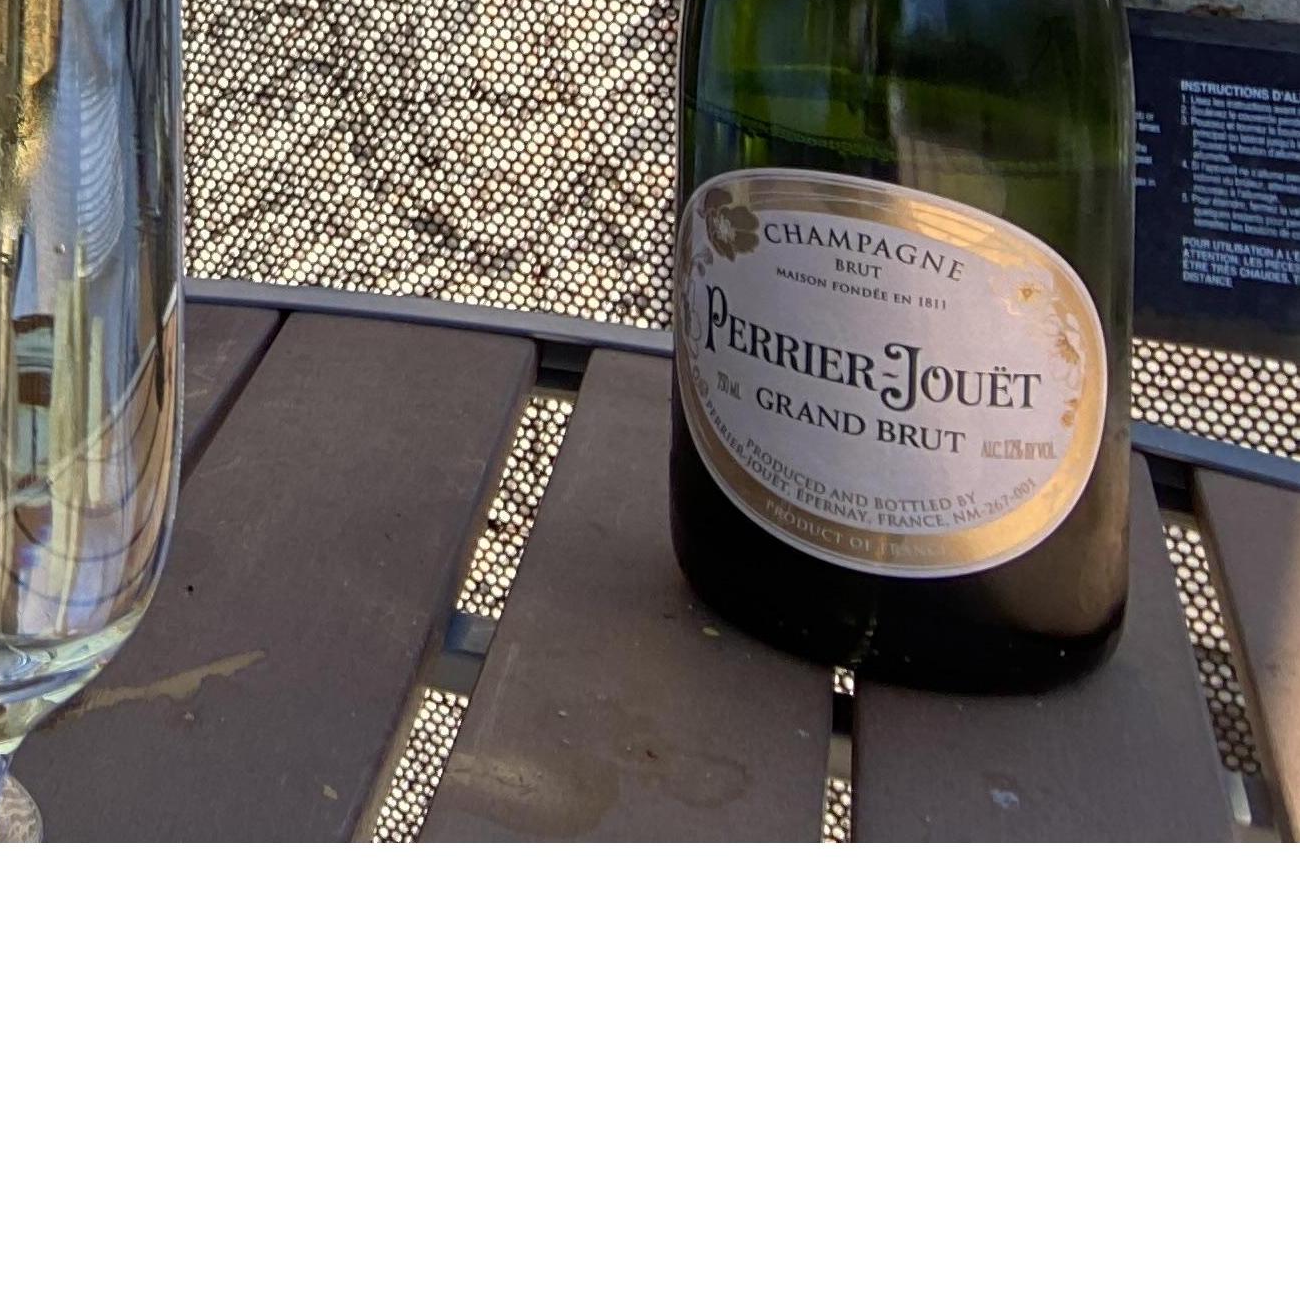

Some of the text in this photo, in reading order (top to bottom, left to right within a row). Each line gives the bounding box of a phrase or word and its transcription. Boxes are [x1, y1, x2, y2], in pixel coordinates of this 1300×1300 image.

[1181, 80, 1300, 103] INSTRUCTIONS D'AL
[764, 223, 965, 282] CHAMPAGNE
[835, 258, 882, 279] BRUT
[777, 267, 947, 309] MAISON FONDÉE EN 1811
[705, 284, 1042, 412] PERRIER-JOUËT
[756, 387, 966, 453] GRAND BRUT
[747, 438, 977, 512] PRODUCED AND BOTTLED BY
[766, 499, 842, 545] PRODUCT
